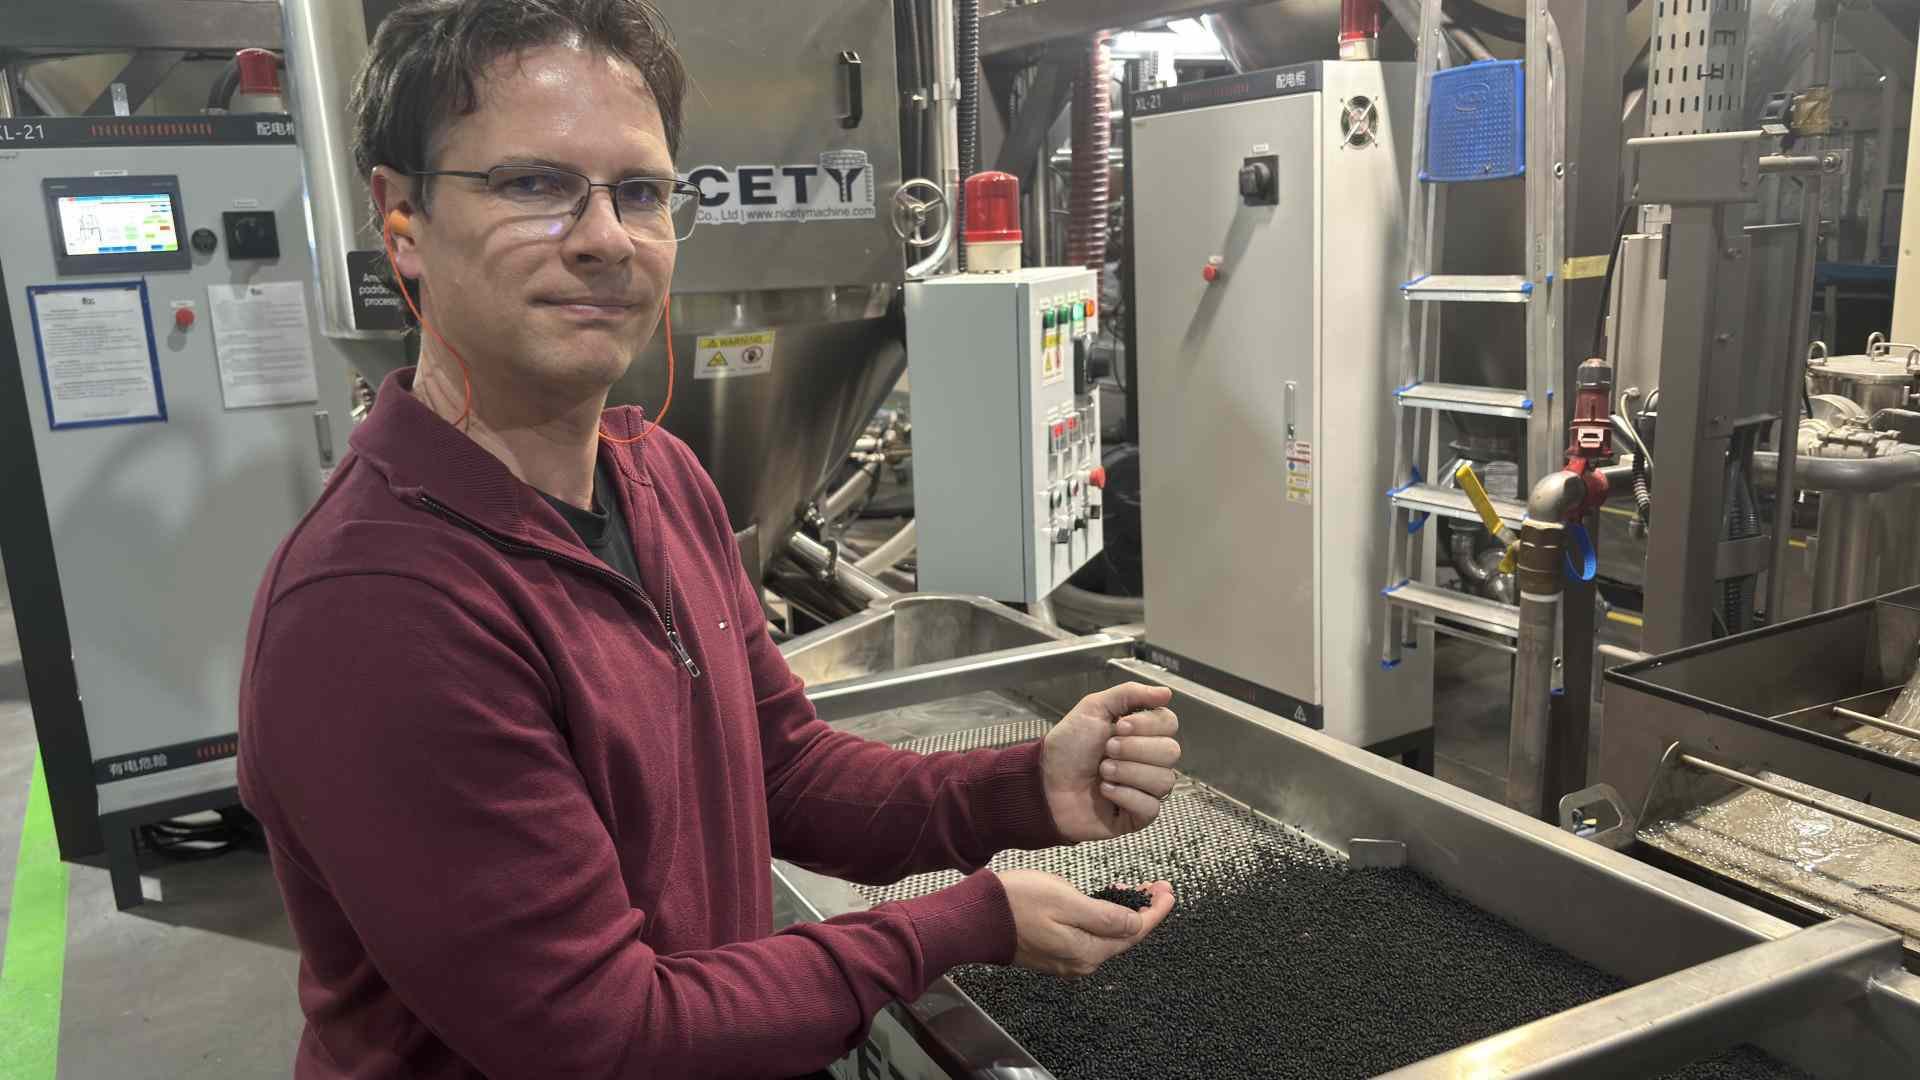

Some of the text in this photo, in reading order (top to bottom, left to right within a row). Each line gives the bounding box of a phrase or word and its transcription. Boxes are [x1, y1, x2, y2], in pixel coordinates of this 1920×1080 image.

[688, 166, 865, 207] CETY
[721, 208, 739, 221] Ltd
[746, 207, 875, 222] www.nicetymachine.com
